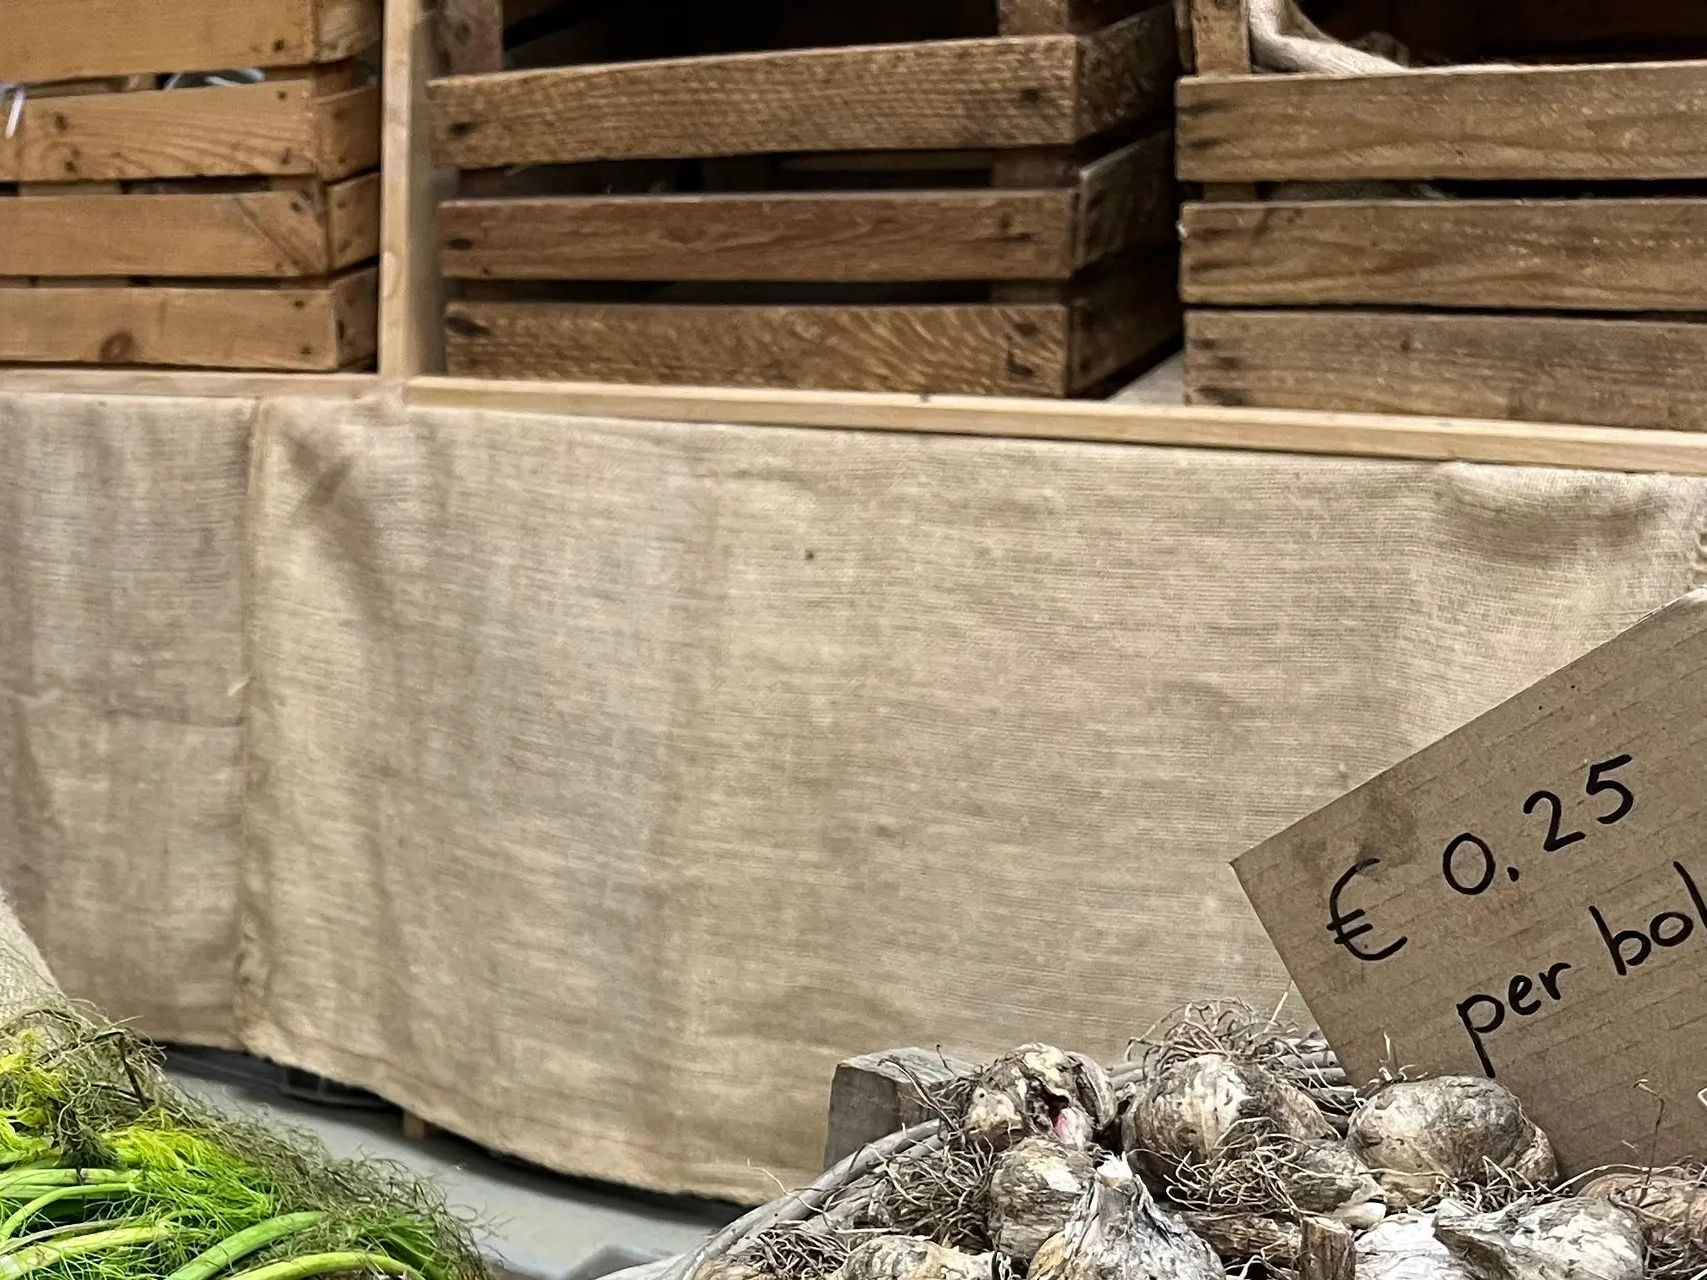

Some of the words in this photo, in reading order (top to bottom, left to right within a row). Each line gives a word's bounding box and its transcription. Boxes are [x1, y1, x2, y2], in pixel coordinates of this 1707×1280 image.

[1326, 857, 1408, 961] €
[1442, 754, 1635, 896] 0.25
[1456, 962, 1572, 1078] per
[1588, 860, 1707, 976] bol
